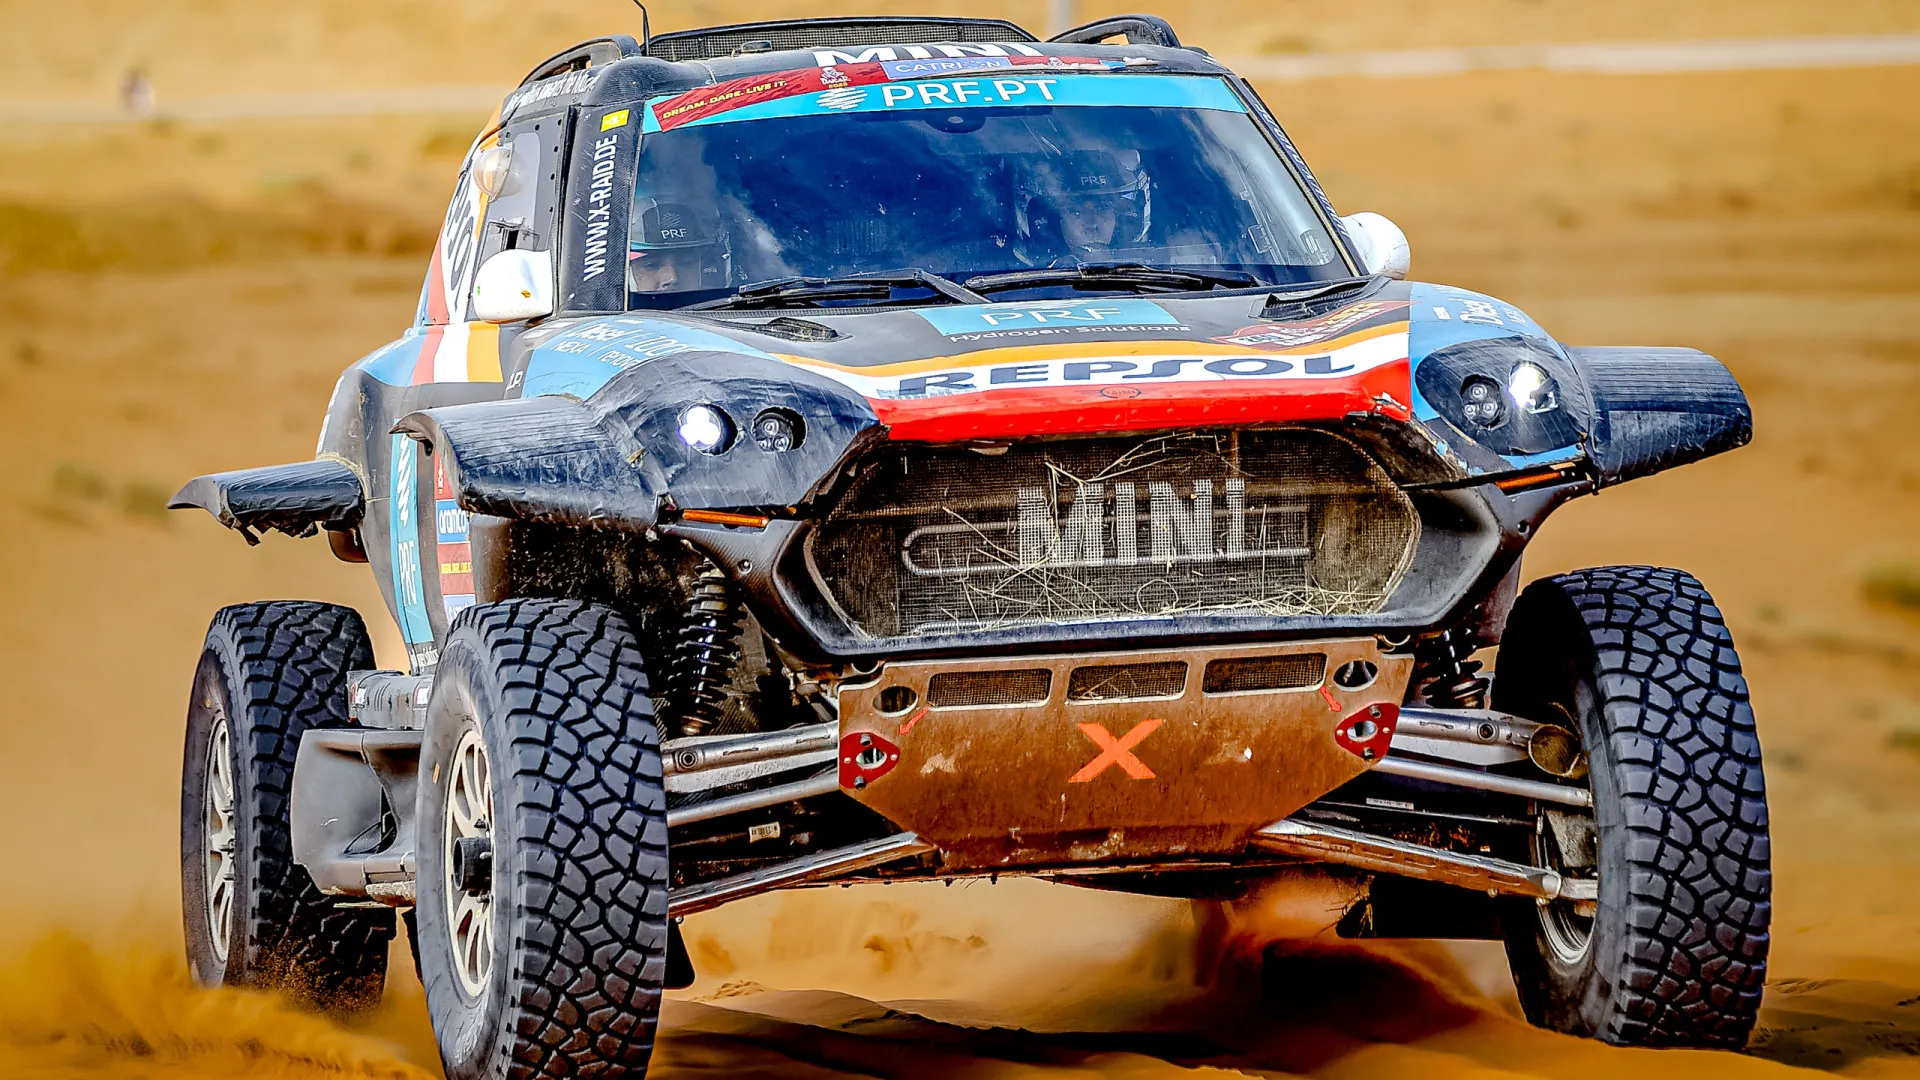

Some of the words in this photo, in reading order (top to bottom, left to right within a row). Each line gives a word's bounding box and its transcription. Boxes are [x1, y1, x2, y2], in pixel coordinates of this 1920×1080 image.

[812, 43, 1044, 67] MINI
[662, 101, 708, 119] DREAM.
[709, 90, 745, 104] DARE.
[746, 83, 772, 94] LIVE
[882, 79, 1058, 107] PRF.PT
[583, 134, 618, 282] WWW.X-RAID.DE
[661, 228, 687, 239] PRF
[980, 307, 1122, 326] PRF
[950, 327, 1070, 343] Hydrogen
[1075, 324, 1192, 333] Solutions
[898, 356, 1355, 396] REPSOL
[438, 508, 467, 534] aramco
[1018, 478, 1245, 567] MINI
[398, 540, 417, 606] PRF
